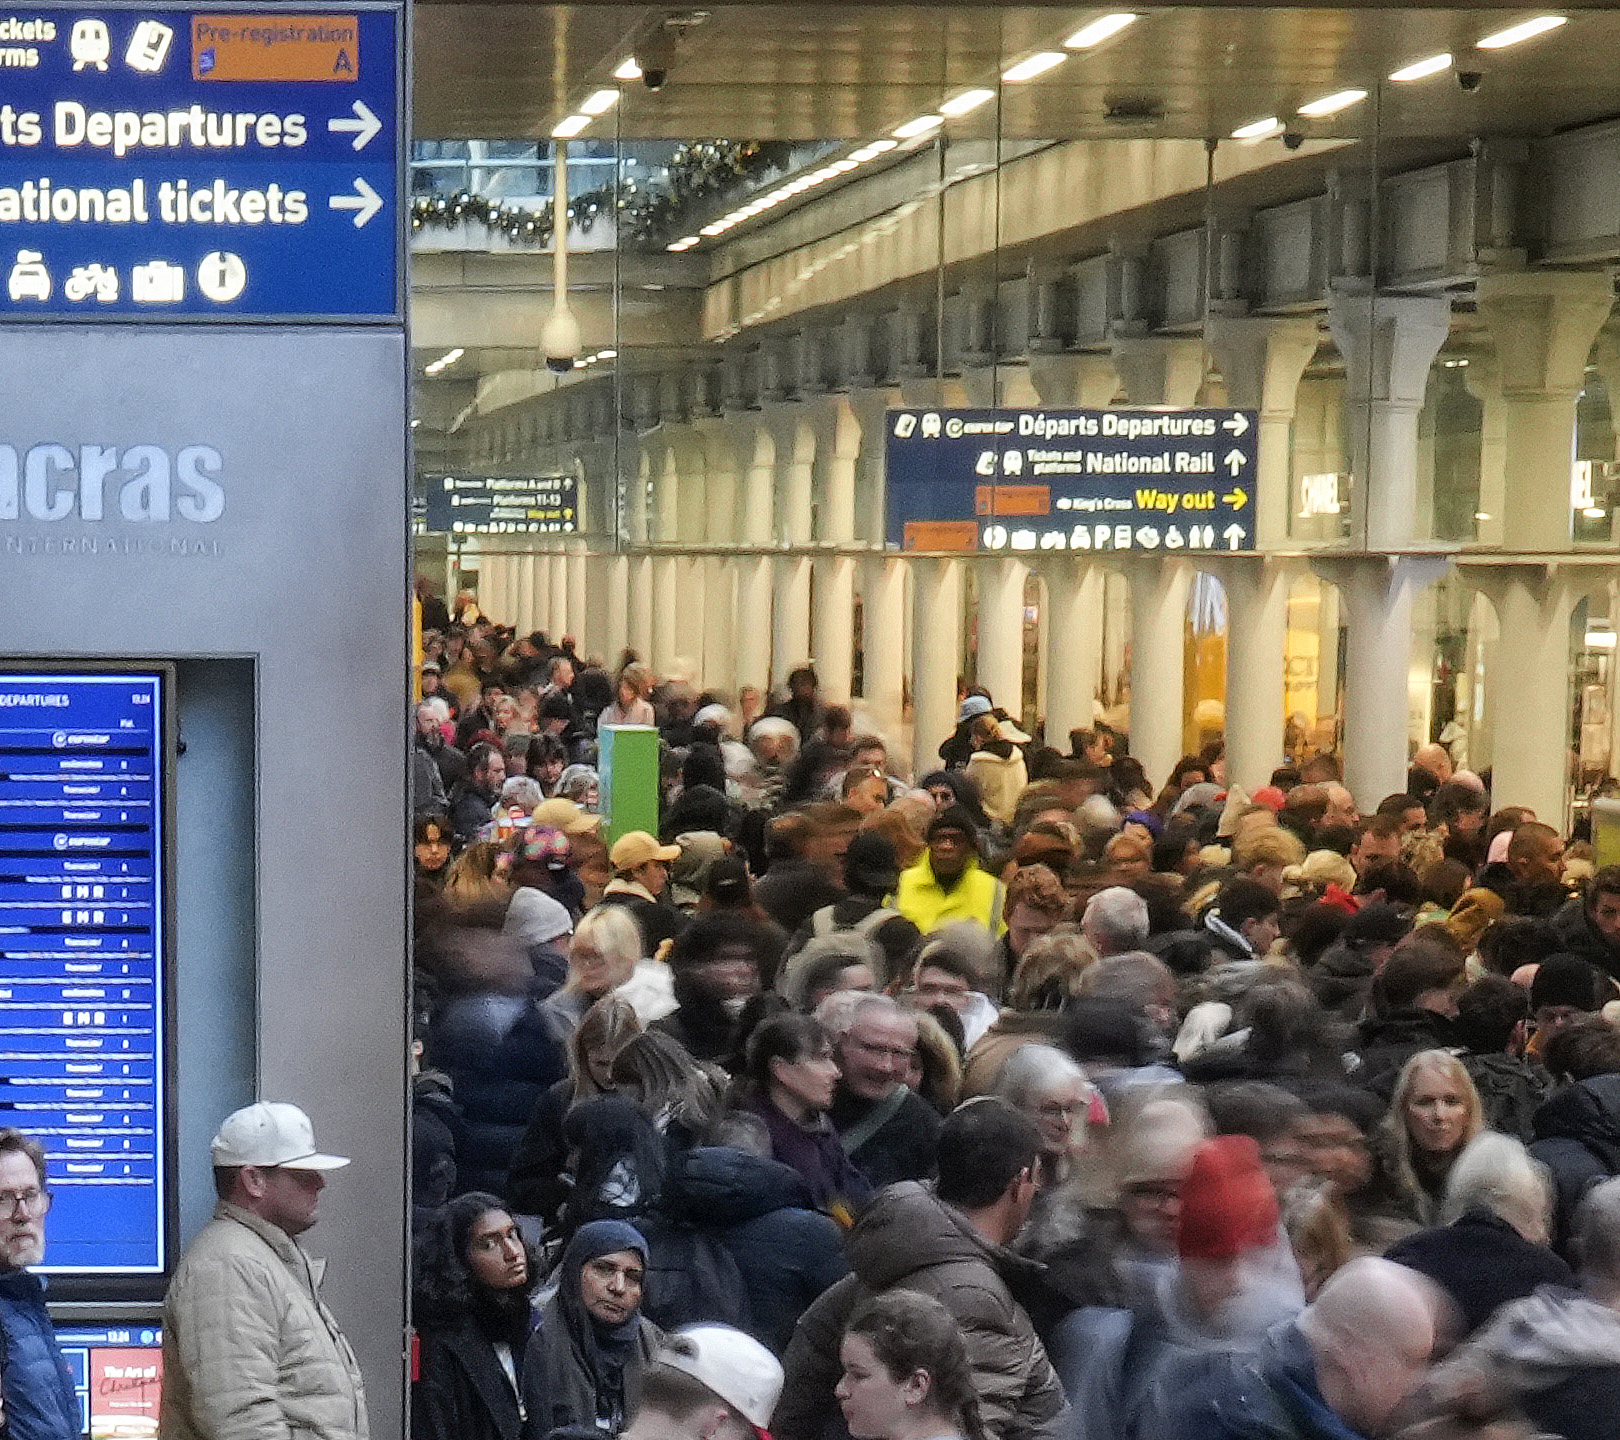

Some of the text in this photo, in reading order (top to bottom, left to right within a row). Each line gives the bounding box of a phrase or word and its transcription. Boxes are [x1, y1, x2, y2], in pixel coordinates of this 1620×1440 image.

[197, 23, 354, 49] Pre-registration
[333, 49, 350, 74] A
[55, 101, 307, 156] Departures
[159, 178, 308, 223] tickets
[1019, 414, 1098, 438] Départs
[1102, 414, 1215, 440] Departures
[1087, 451, 1214, 474] National Rail
[1136, 488, 1215, 514] Way out
[0, 694, 69, 707] DEPARTURES
[103, 1366, 123, 1378] The
[124, 1366, 143, 1378] Art
